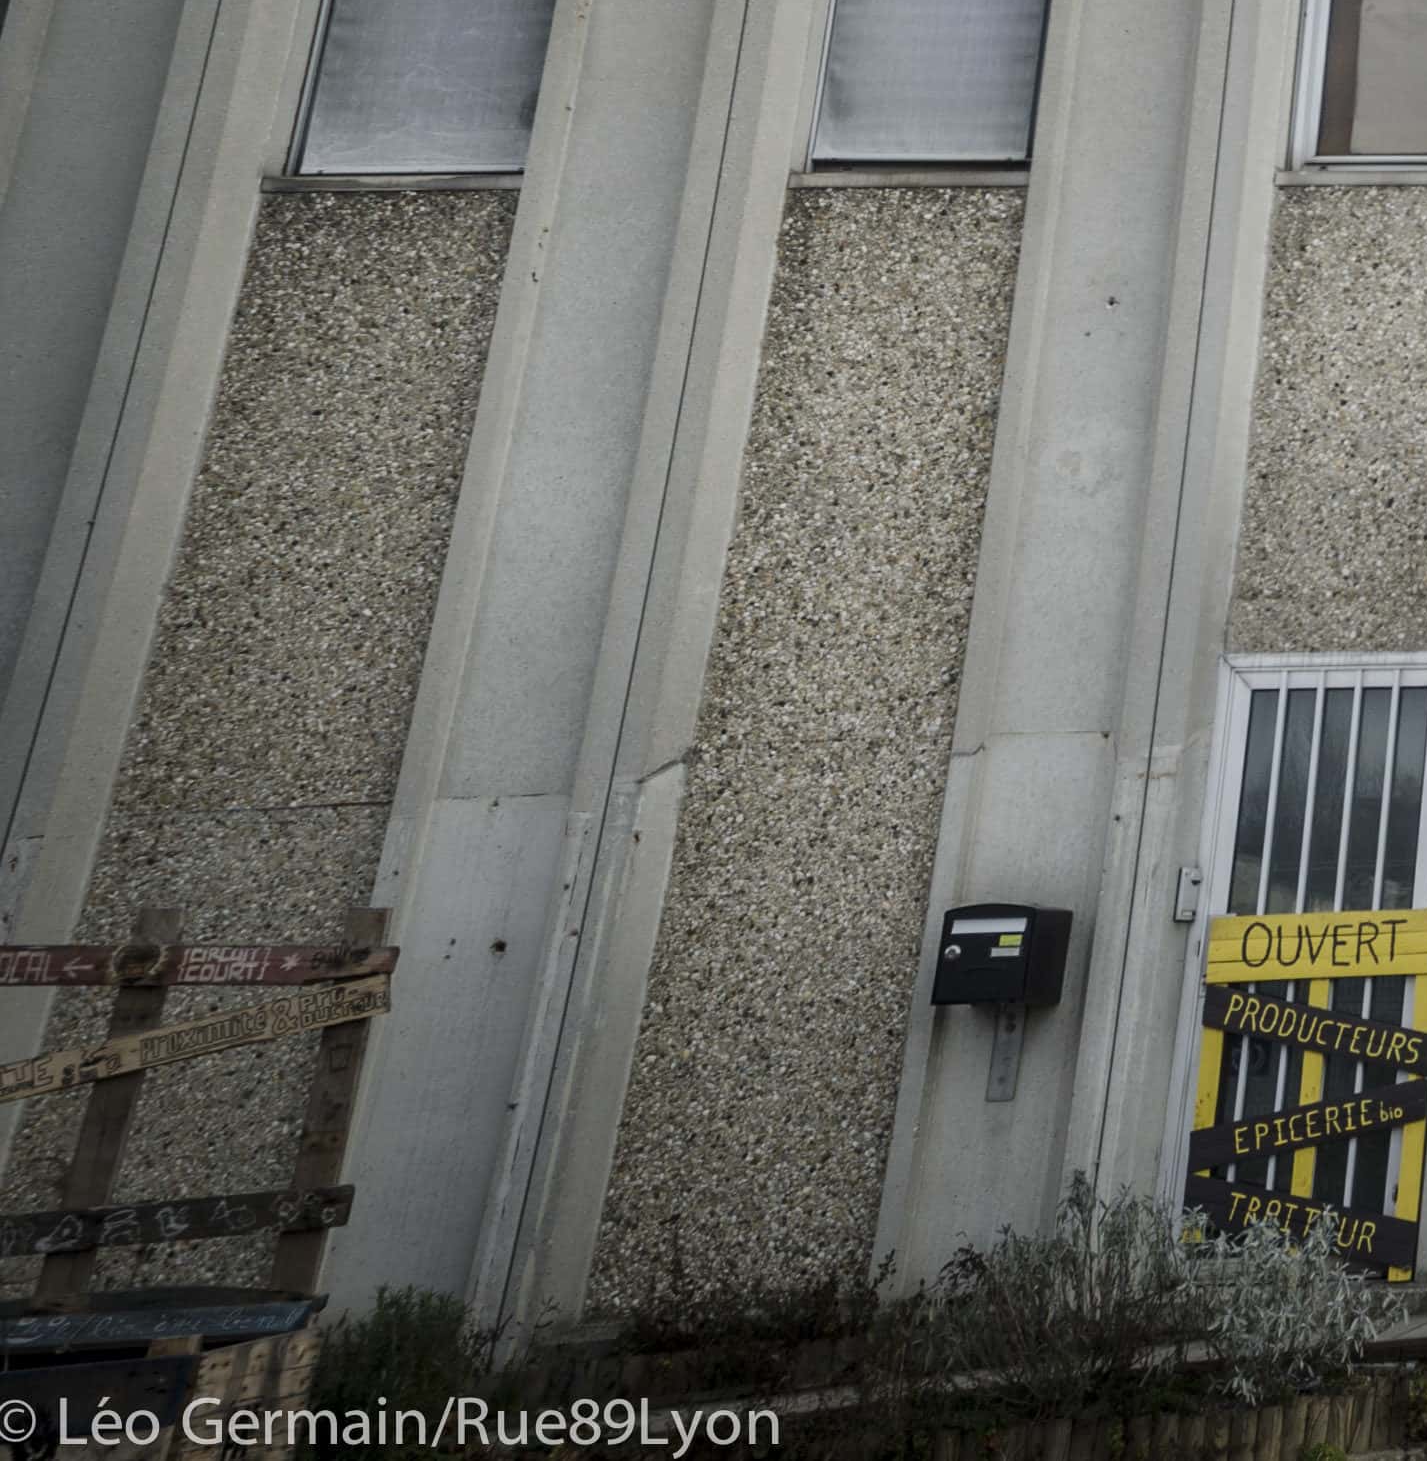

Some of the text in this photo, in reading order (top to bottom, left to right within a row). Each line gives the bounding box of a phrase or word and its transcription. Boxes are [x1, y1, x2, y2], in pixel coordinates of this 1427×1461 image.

[1241, 919, 1408, 969] OUVERT
[1223, 993, 1423, 1065] PRODUCTEURS
[1234, 1099, 1404, 1155] EPICERIE bio
[1229, 1191, 1377, 1254] TRAITUR
